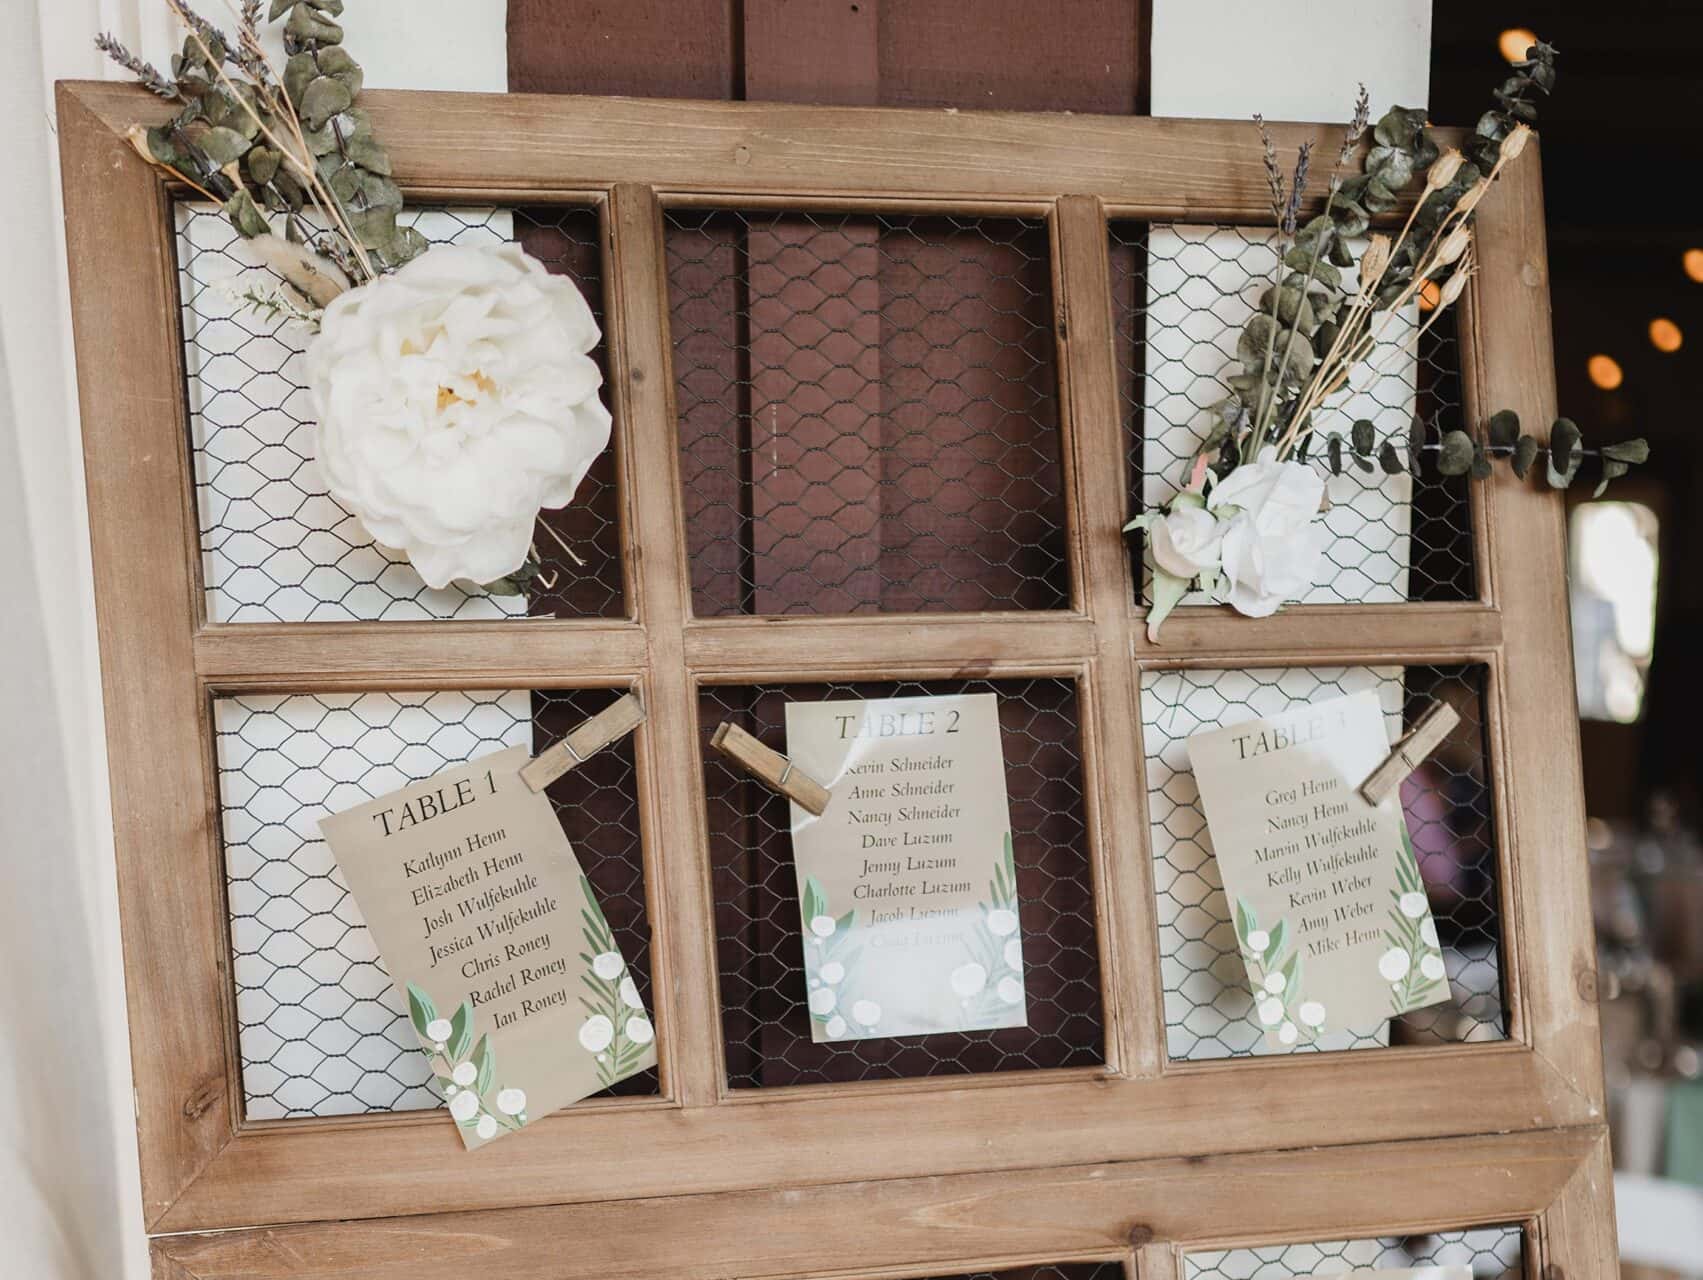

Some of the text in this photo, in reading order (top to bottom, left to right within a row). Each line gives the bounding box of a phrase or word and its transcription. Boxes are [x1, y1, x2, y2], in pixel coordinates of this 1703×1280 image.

[946, 710, 959, 733] 2
[889, 755, 953, 772] Schneider
[372, 770, 496, 836] TABLE 1
[848, 780, 954, 799] Anne Schneider
[1265, 778, 1336, 806] Greg Henn
[848, 804, 960, 825] Nancy Schneider
[1267, 803, 1348, 832] Nancy Henn
[403, 829, 506, 878] Katlynn Henn
[862, 832, 952, 848] Dave Luzum
[1255, 818, 1376, 864] Marvin Wulfekuhle
[411, 852, 523, 906] Elizabeth Henn
[859, 856, 956, 878] Jenny Luzum
[1267, 844, 1378, 887] Kelly Wulfekuhle
[853, 880, 970, 899] Charlotte Luzum
[1289, 876, 1370, 908] Kevin Weber
[423, 874, 536, 939] Josh Wulfekuhle
[867, 906, 957, 927] Jacob Luzum
[1298, 902, 1373, 933] Amy Weber
[429, 897, 556, 968] Jessica Wulfekuhle
[1308, 928, 1380, 957] Mike Henn
[461, 934, 550, 978] Chris Roney
[469, 958, 566, 1008] Rachel Roney
[493, 989, 567, 1029] Ian Roney
